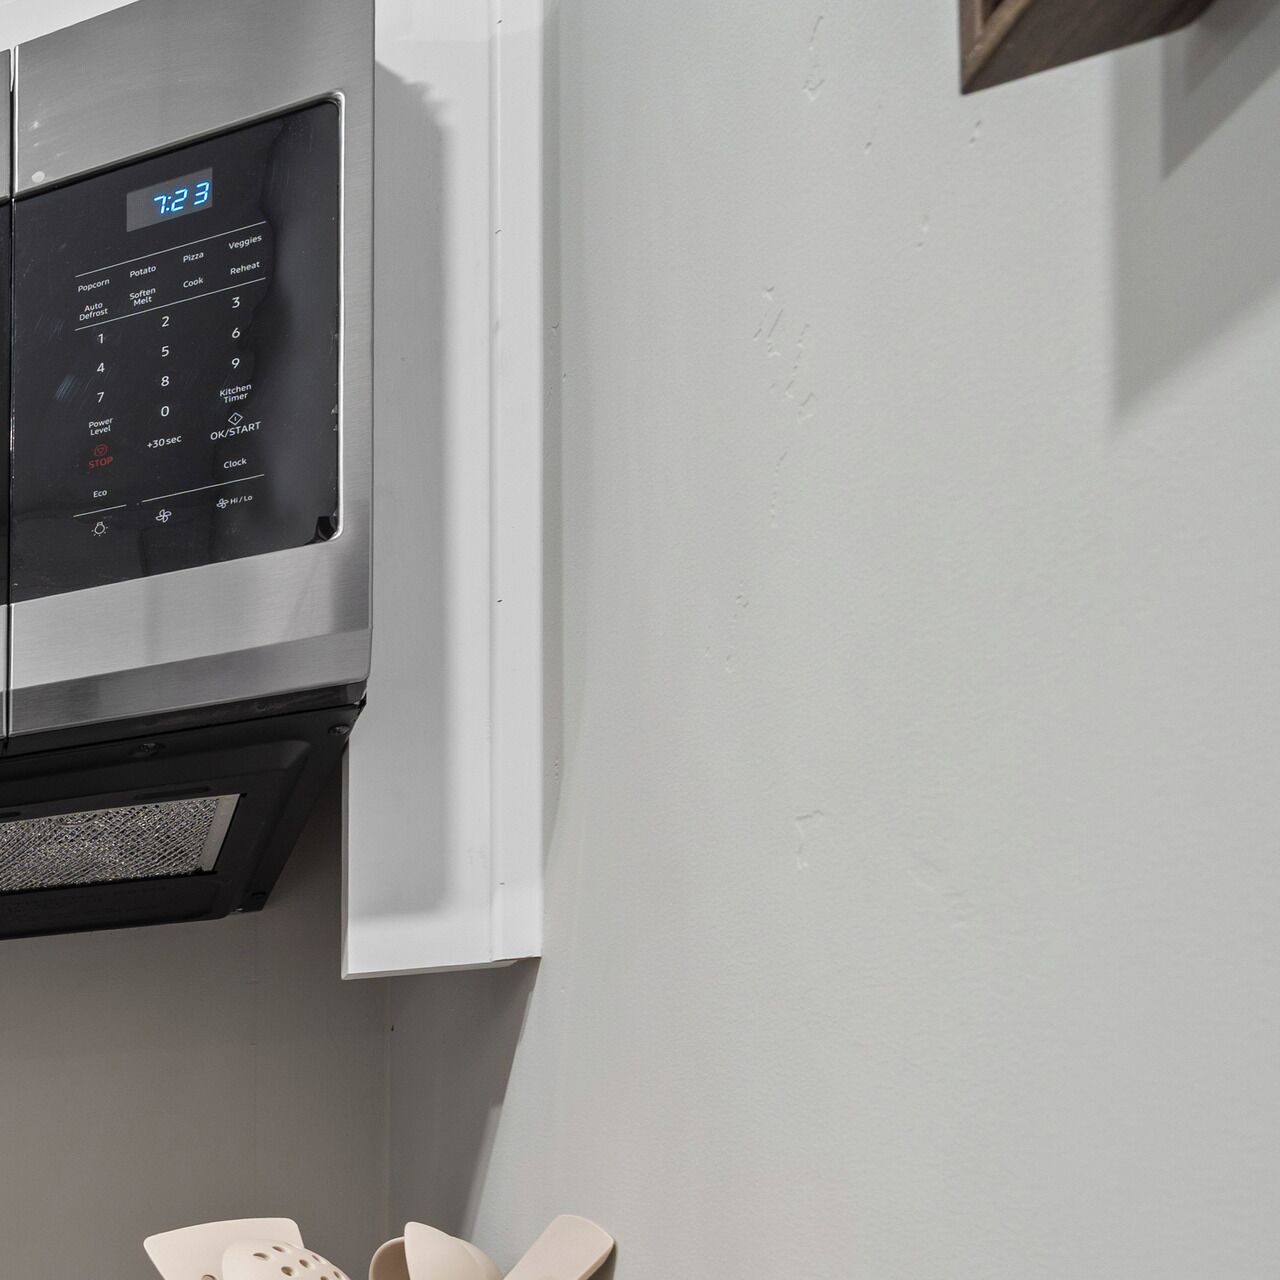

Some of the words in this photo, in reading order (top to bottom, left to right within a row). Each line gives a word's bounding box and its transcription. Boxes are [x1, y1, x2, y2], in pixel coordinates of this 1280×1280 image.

[153, 181, 211, 215] 7:23
[228, 234, 263, 250] Veggies
[182, 251, 205, 263] Pizza
[129, 265, 157, 278] Potato
[229, 261, 261, 275] Reheat
[77, 278, 110, 293] Popcorn
[183, 276, 204, 288] Cook
[129, 287, 157, 301] Soften
[84, 302, 103, 313] Auto
[133, 296, 153, 308] Melt
[231, 297, 241, 309] 3
[79, 308, 109, 321] Defrost
[161, 315, 170, 328] 2
[98, 333, 105, 345] 1
[231, 328, 241, 339] 6
[161, 345, 170, 358] 5
[96, 362, 105, 374] 4
[231, 358, 241, 370] 9
[160, 375, 170, 387] 8
[219, 383, 252, 397] Kitchen
[97, 391, 105, 404] 7
[224, 392, 249, 404] Timer
[160, 405, 170, 417] 0
[88, 417, 113, 429] Power
[90, 425, 111, 436] Level
[210, 421, 261, 440] OK/START
[88, 455, 114, 469] STOP
[223, 457, 248, 470] Clock
[93, 489, 108, 498] Eco
